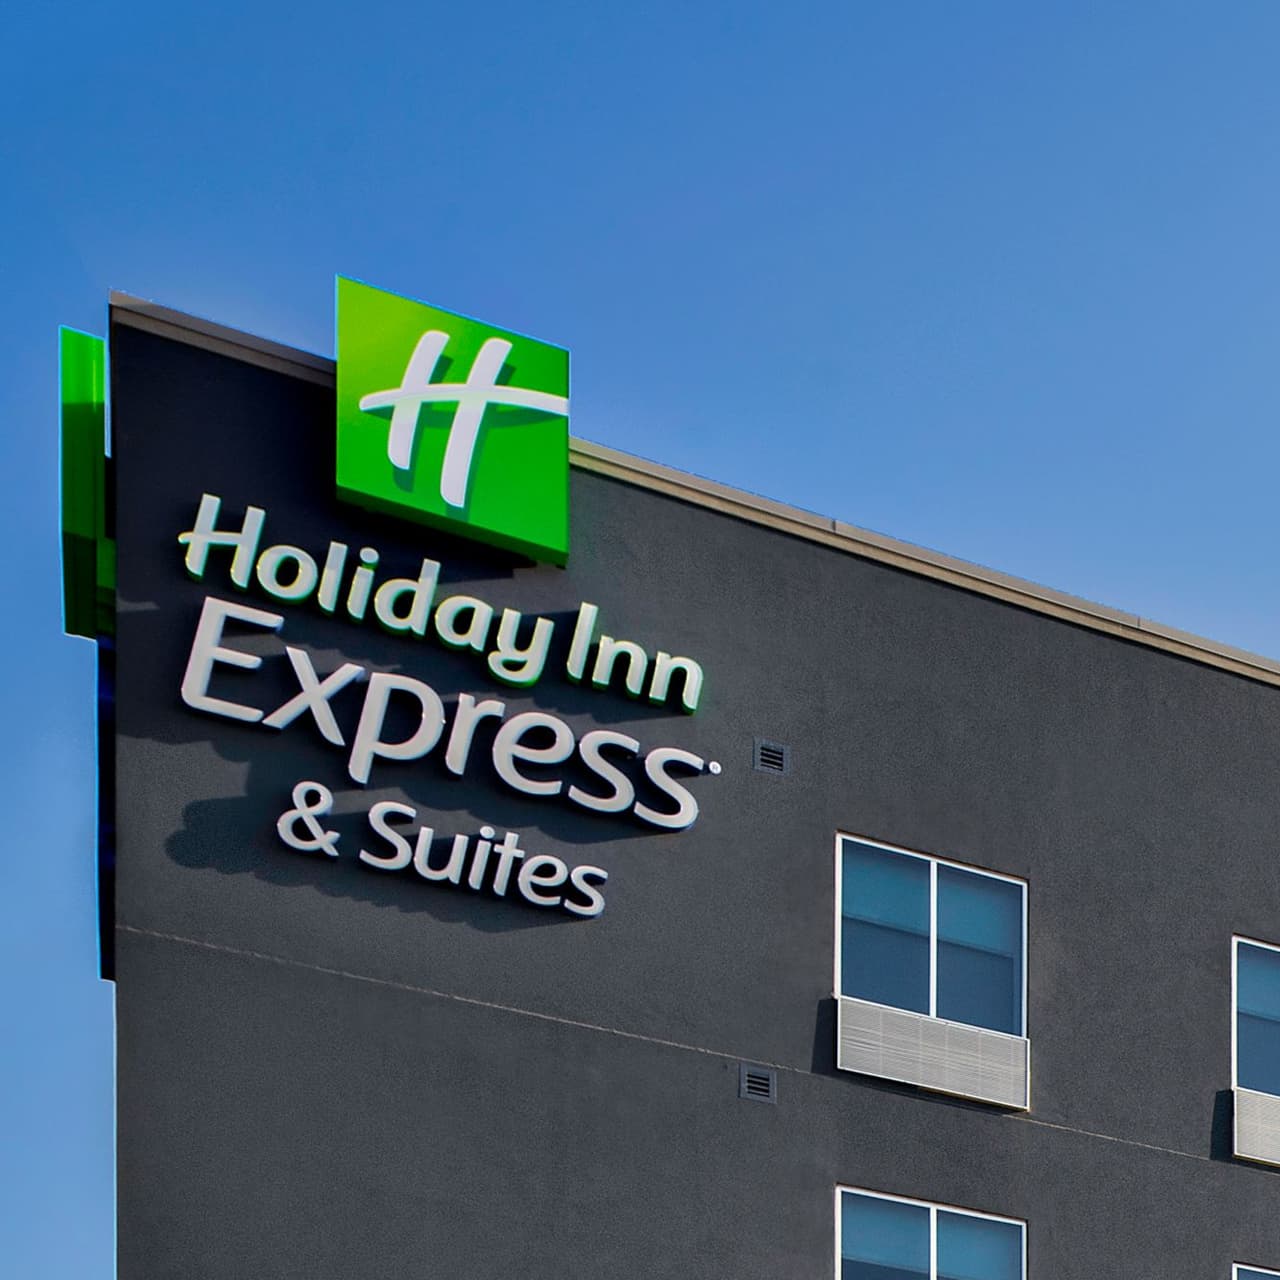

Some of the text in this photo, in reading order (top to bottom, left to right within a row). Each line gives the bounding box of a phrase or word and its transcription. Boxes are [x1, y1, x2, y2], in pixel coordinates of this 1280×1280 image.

[178, 492, 704, 714] Holiday Inn
[276, 781, 609, 918] & Suites
